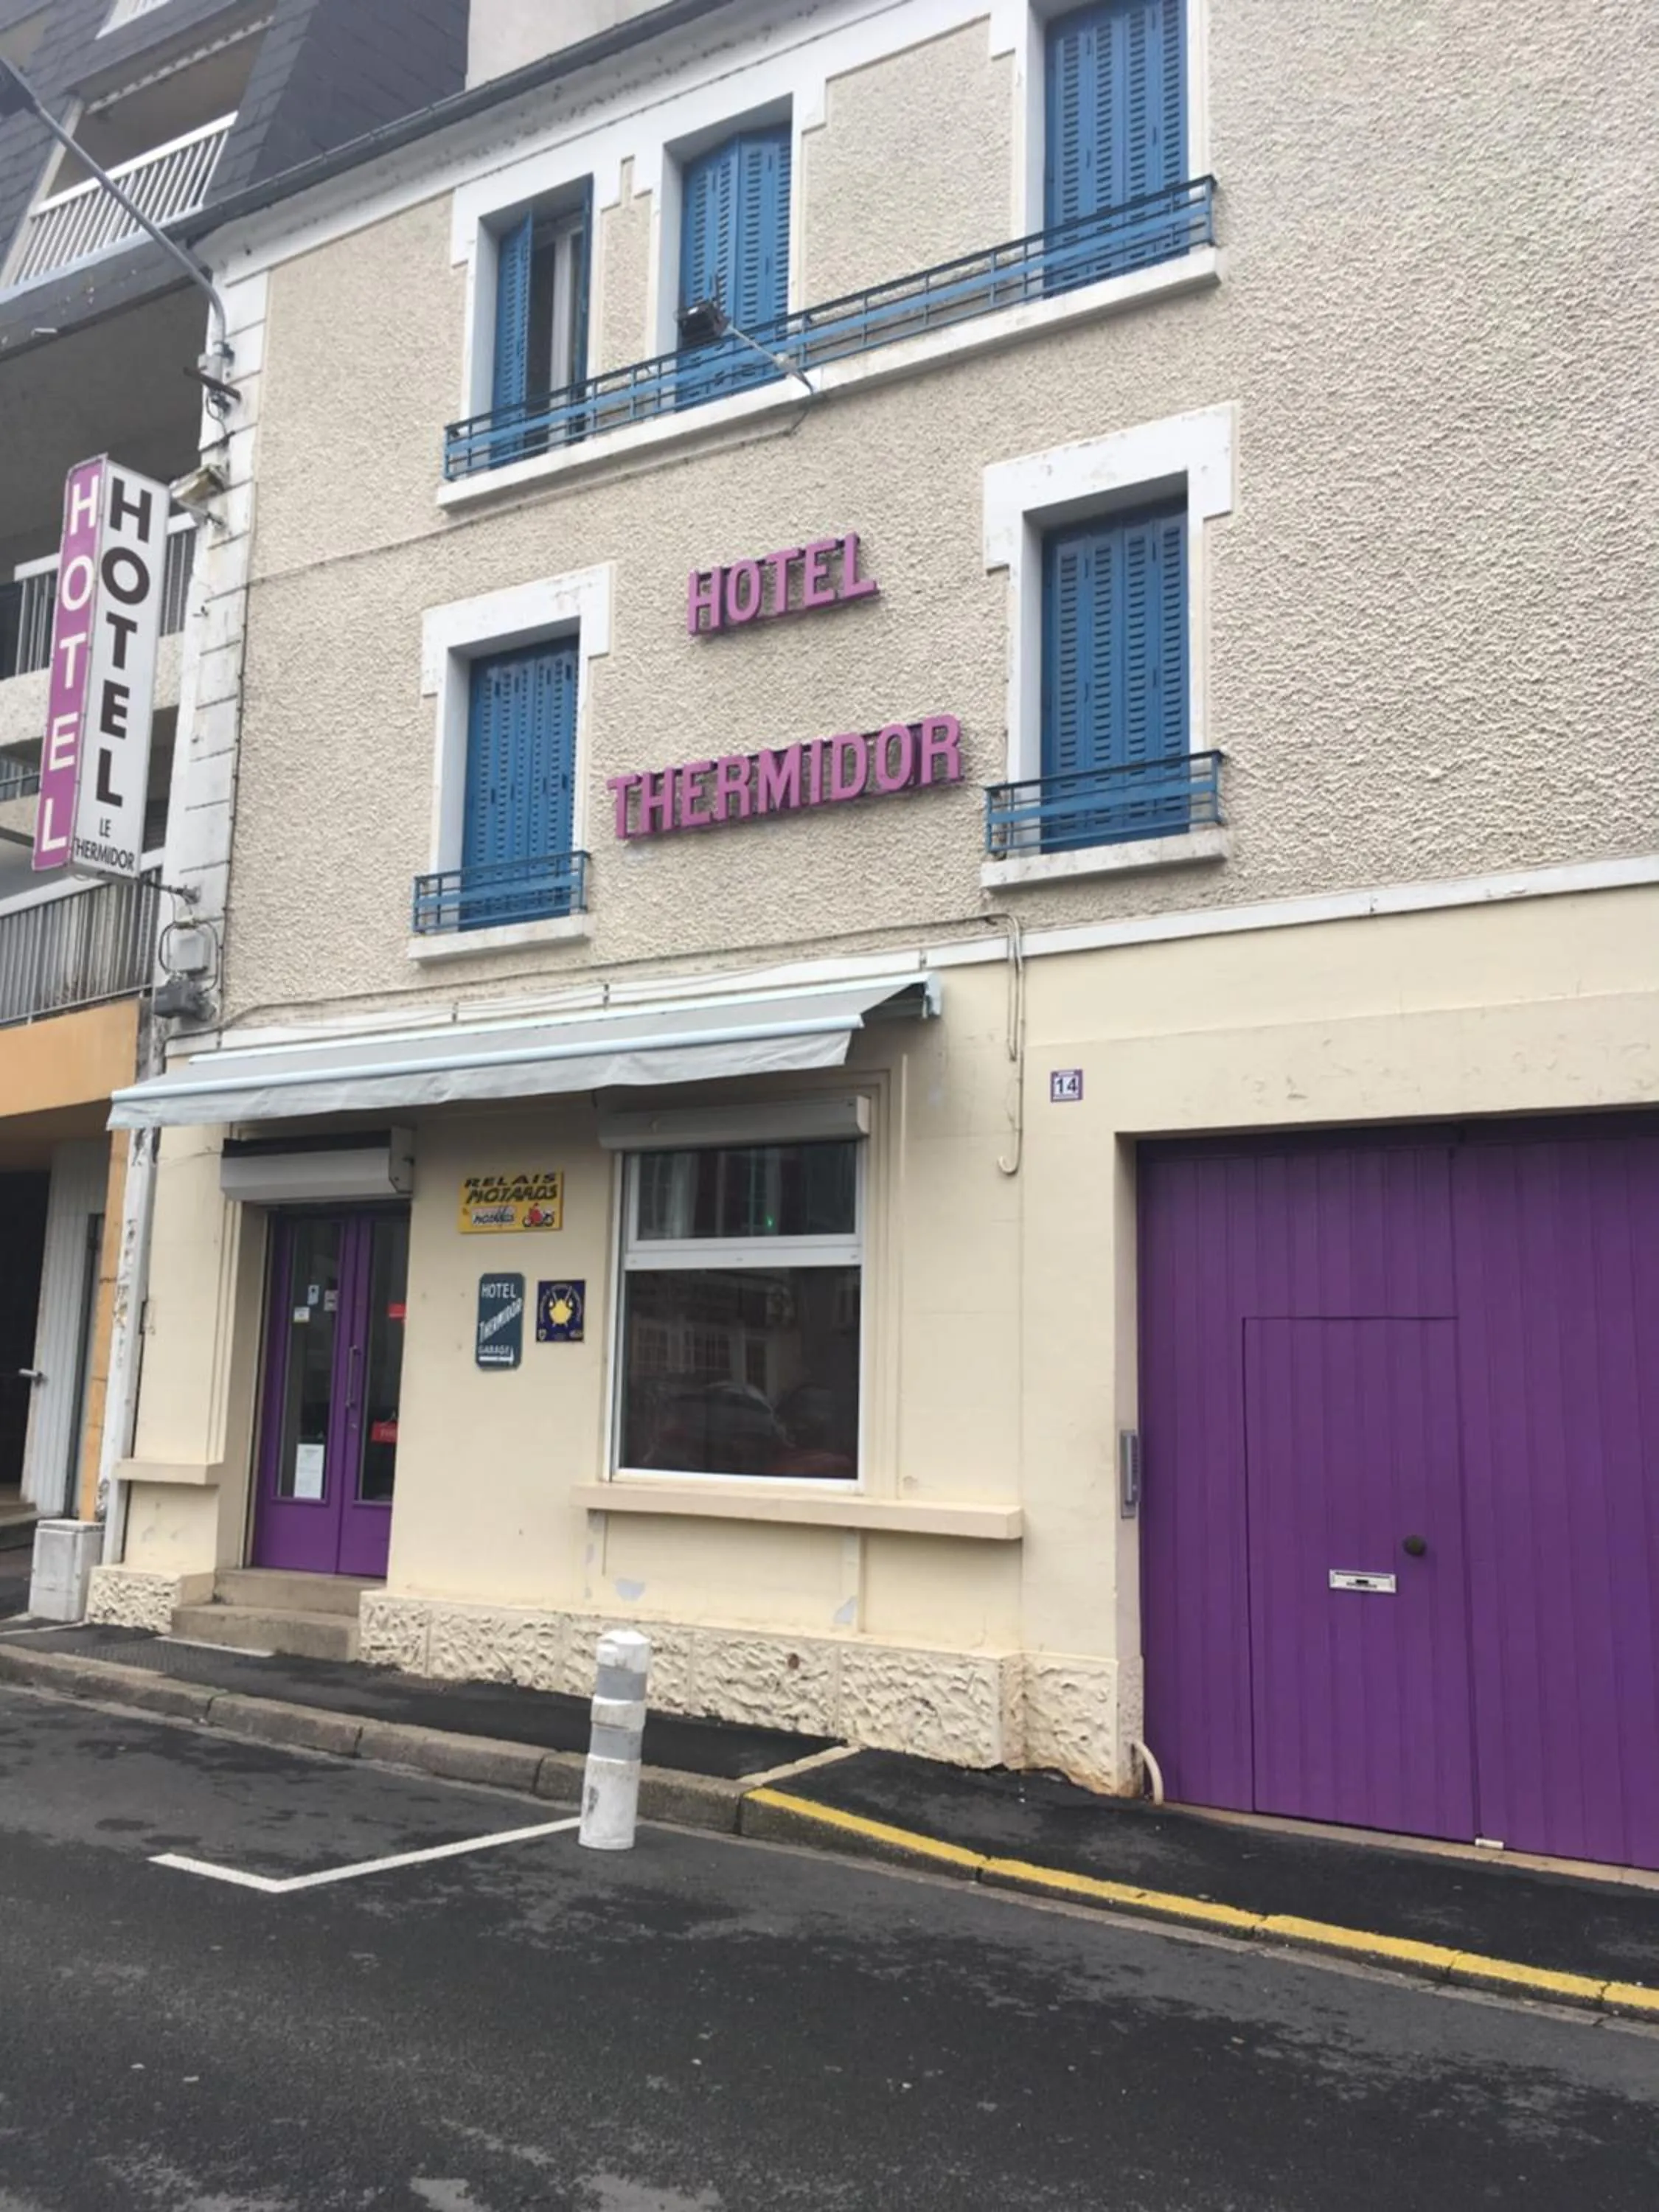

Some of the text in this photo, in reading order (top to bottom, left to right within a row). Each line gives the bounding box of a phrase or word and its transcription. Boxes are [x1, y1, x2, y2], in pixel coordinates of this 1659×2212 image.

[688, 531, 880, 636] HOTEL
[96, 477, 152, 808] HOTEL
[41, 475, 99, 852] HOTEL
[607, 713, 964, 839] THERMIDOR
[100, 818, 111, 838] LE
[1056, 1077, 1077, 1093] 14
[465, 1172, 556, 1188] RELAIS
[466, 1185, 558, 1204] MOTARDS
[481, 1283, 516, 1298] HOTEL
